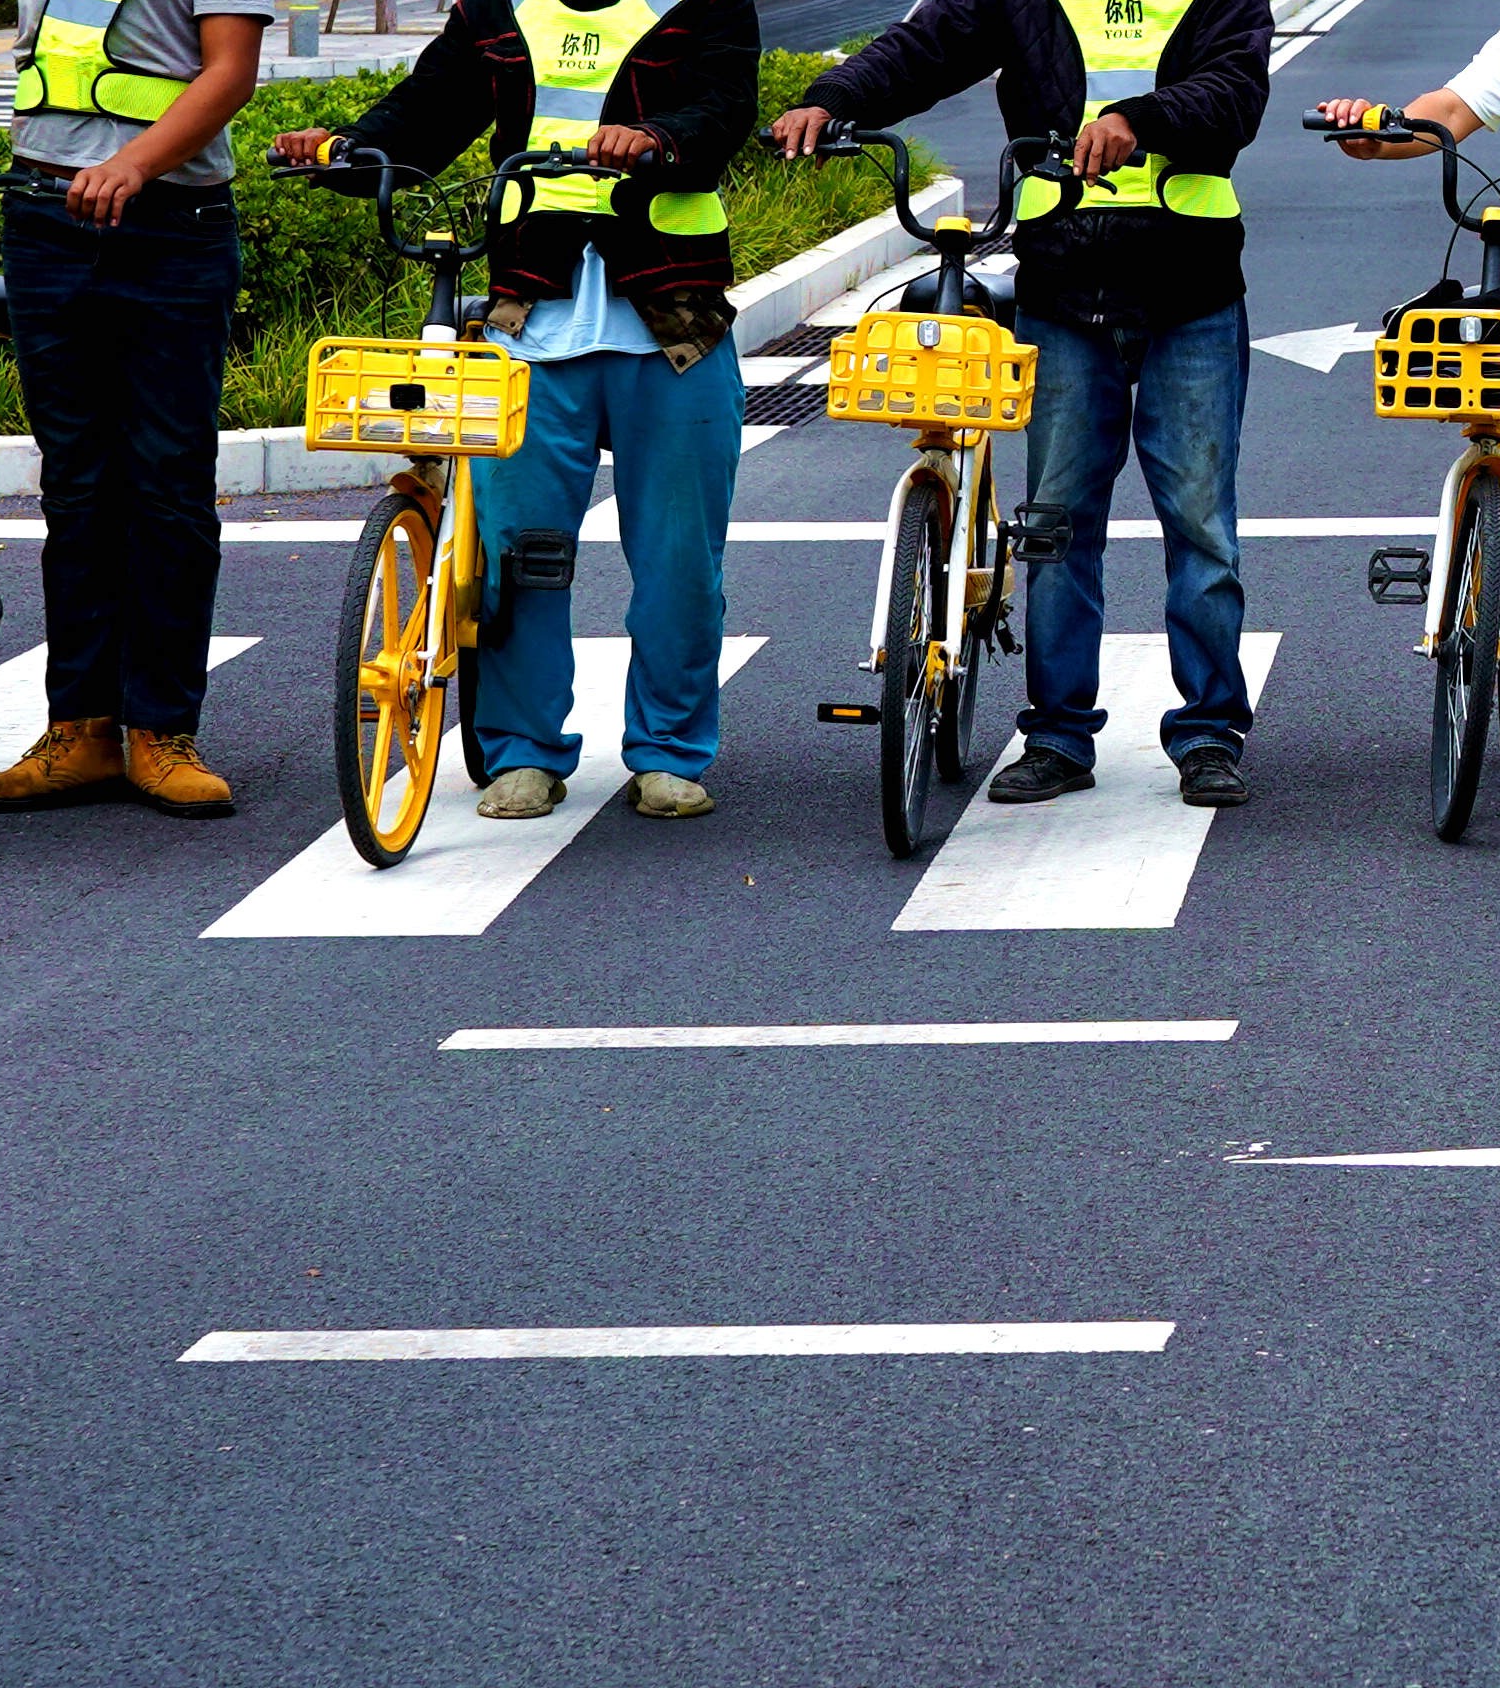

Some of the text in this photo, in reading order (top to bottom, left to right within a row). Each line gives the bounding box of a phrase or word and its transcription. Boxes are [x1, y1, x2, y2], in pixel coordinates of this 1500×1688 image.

[1104, 29, 1143, 40] YOUR
[561, 32, 600, 56] 你们
[557, 60, 597, 70] YOUR
